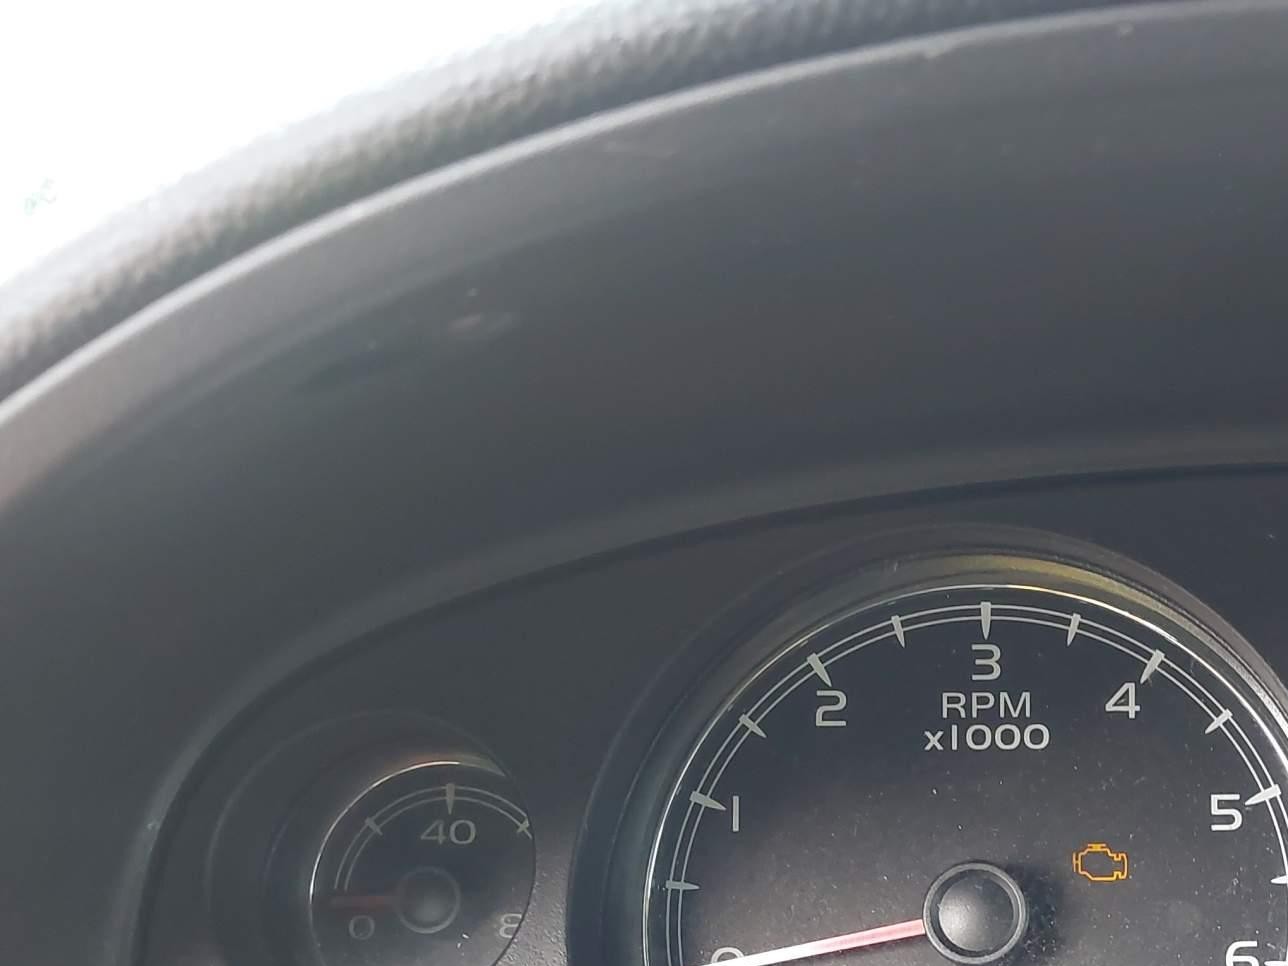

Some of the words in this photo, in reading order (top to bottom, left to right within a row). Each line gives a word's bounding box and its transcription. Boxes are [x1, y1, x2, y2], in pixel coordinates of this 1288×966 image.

[971, 644, 1001, 681] 3
[815, 690, 847, 727] 2
[942, 691, 1031, 719] RPM
[1105, 681, 1141, 719] 4
[924, 723, 1050, 751] x1000
[732, 795, 740, 832] 1
[1210, 793, 1243, 831] 5
[420, 819, 477, 845] 40
[347, 914, 375, 941] 0
